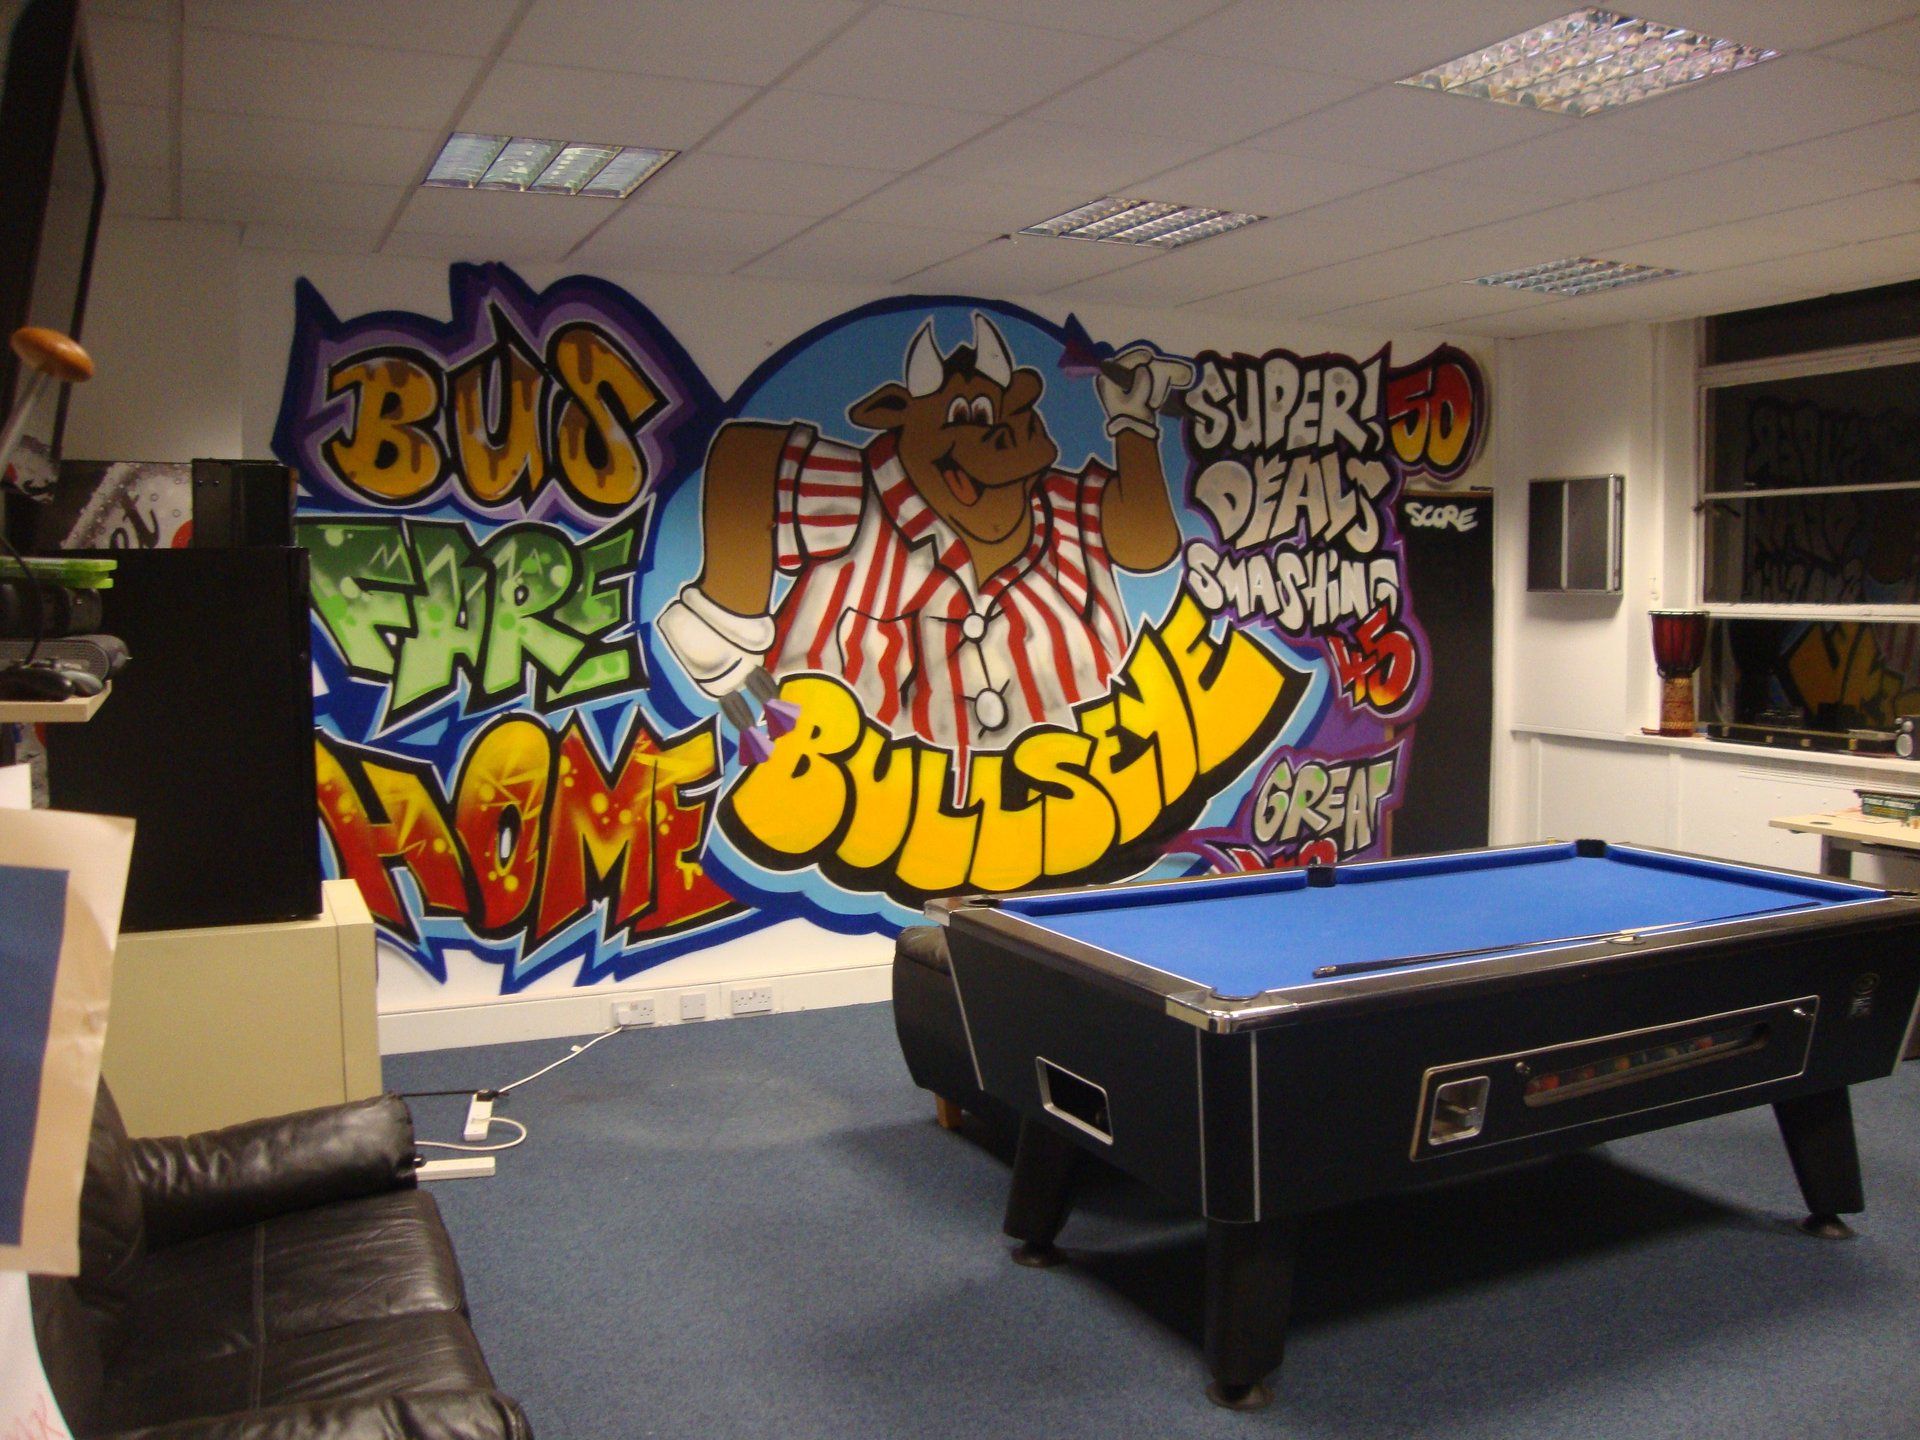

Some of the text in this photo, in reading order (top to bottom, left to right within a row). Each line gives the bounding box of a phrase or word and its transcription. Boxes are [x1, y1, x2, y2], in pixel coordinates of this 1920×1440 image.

[321, 310, 668, 510] BUS
[1388, 362, 1473, 467] 50
[1195, 453, 1391, 553] DEALS
[1404, 502, 1479, 532] SCORE
[296, 513, 648, 720] FARE
[1327, 605, 1416, 707] 45
[727, 593, 1288, 893] BULLSEYE
[314, 714, 742, 946] HOME
[1253, 755, 1396, 852] GREAT
